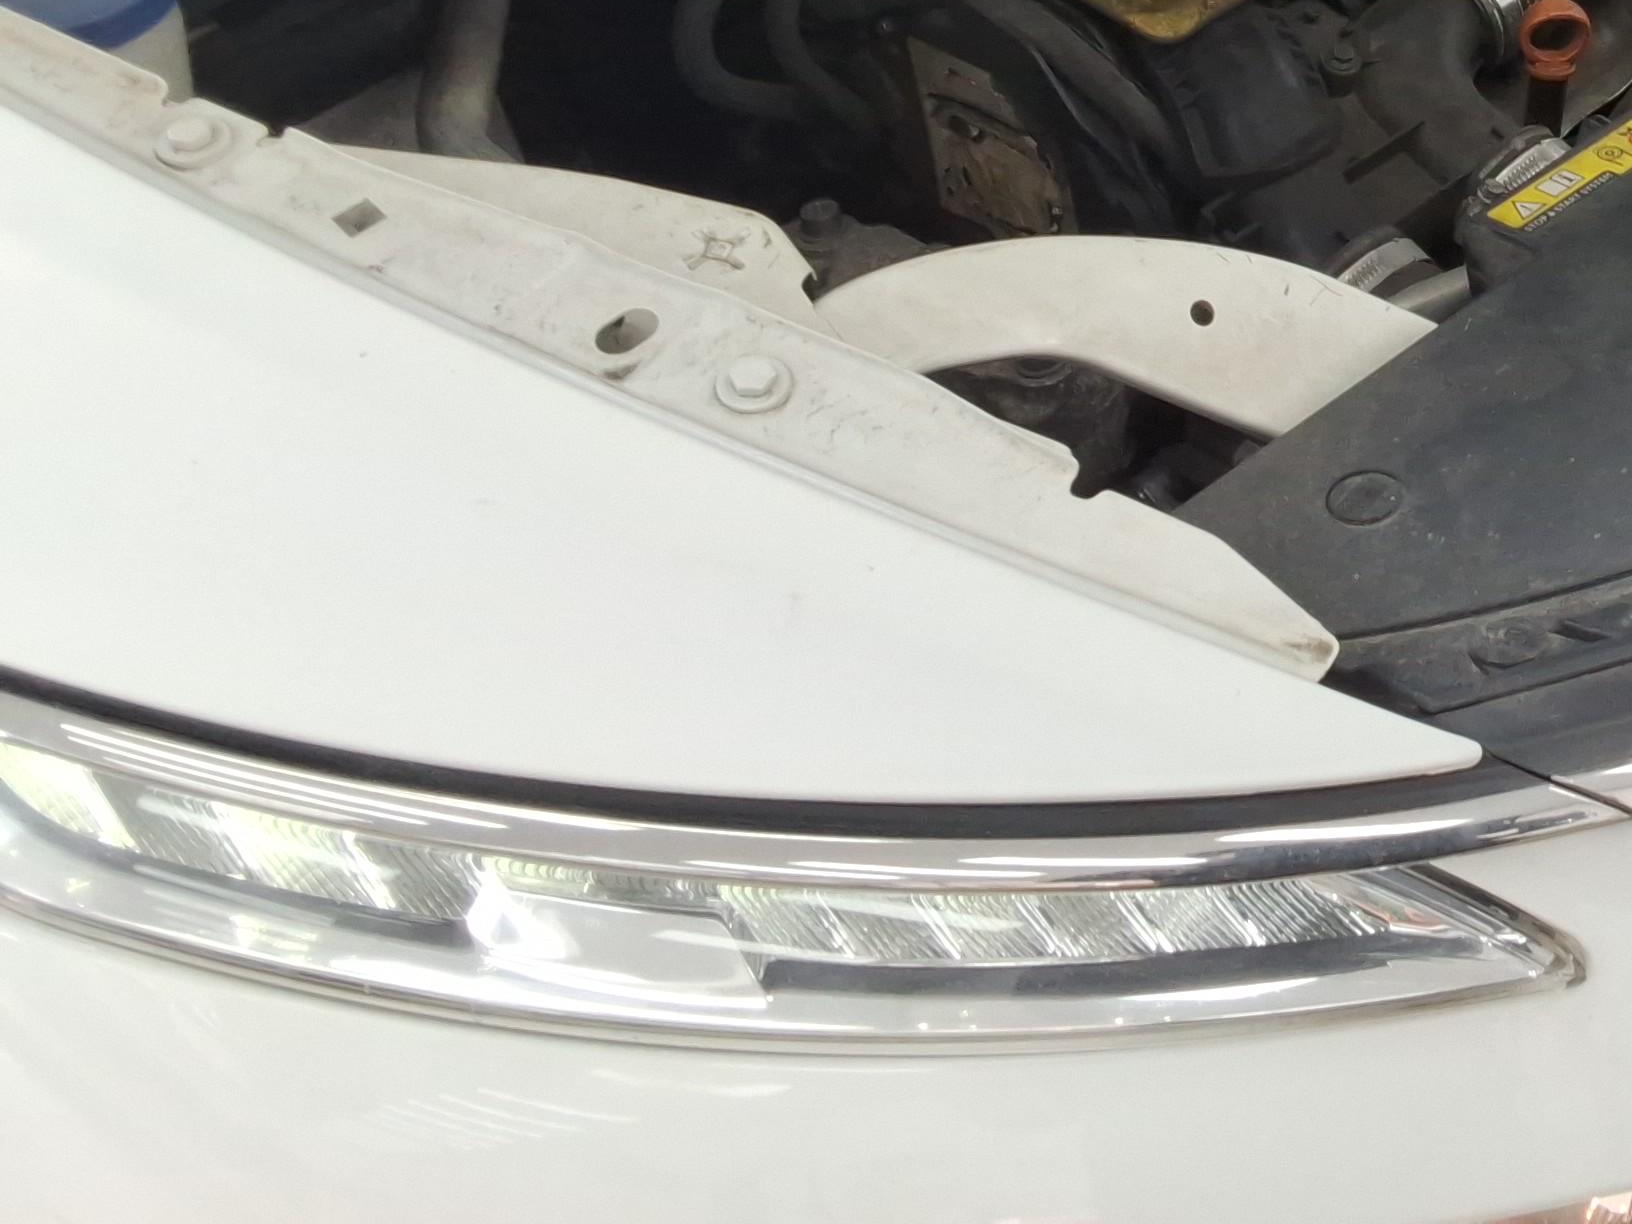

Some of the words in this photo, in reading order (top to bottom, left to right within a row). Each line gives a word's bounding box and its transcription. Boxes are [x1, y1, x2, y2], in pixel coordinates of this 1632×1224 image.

[1524, 215, 1548, 232] STOP
[1554, 192, 1581, 212] START
[1580, 172, 1614, 195] SYSTEM
